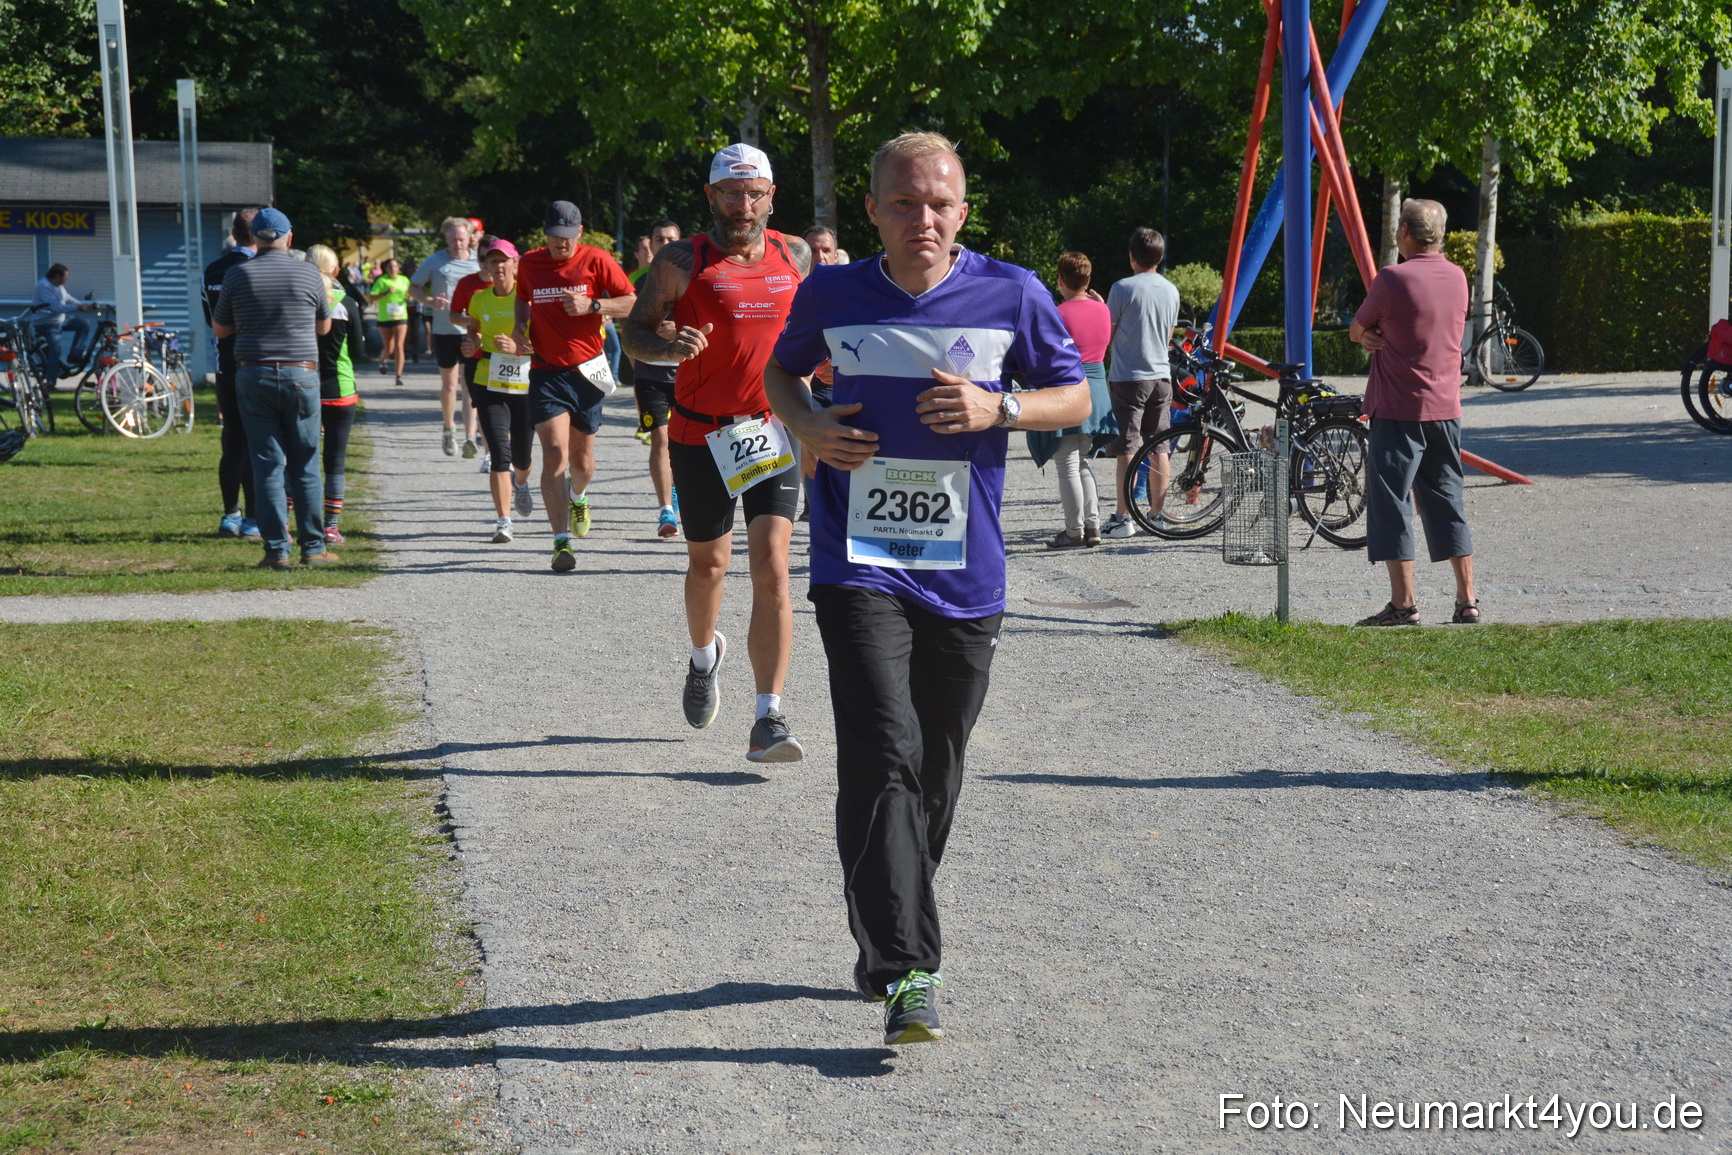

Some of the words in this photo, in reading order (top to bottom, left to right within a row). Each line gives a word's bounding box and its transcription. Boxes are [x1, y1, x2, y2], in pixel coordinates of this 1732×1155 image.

[533, 284, 587, 296] FACKELMANN
[738, 301, 775, 309] Gruber
[498, 364, 521, 378] 294
[727, 424, 761, 438] BOCK
[730, 434, 772, 464] 222
[740, 460, 778, 483] Reinhard
[885, 468, 937, 483] BOCK
[866, 488, 951, 524] 2362
[873, 526, 898, 534] PARTL
[898, 527, 933, 536] Neumarkt
[889, 541, 925, 557] Peter
